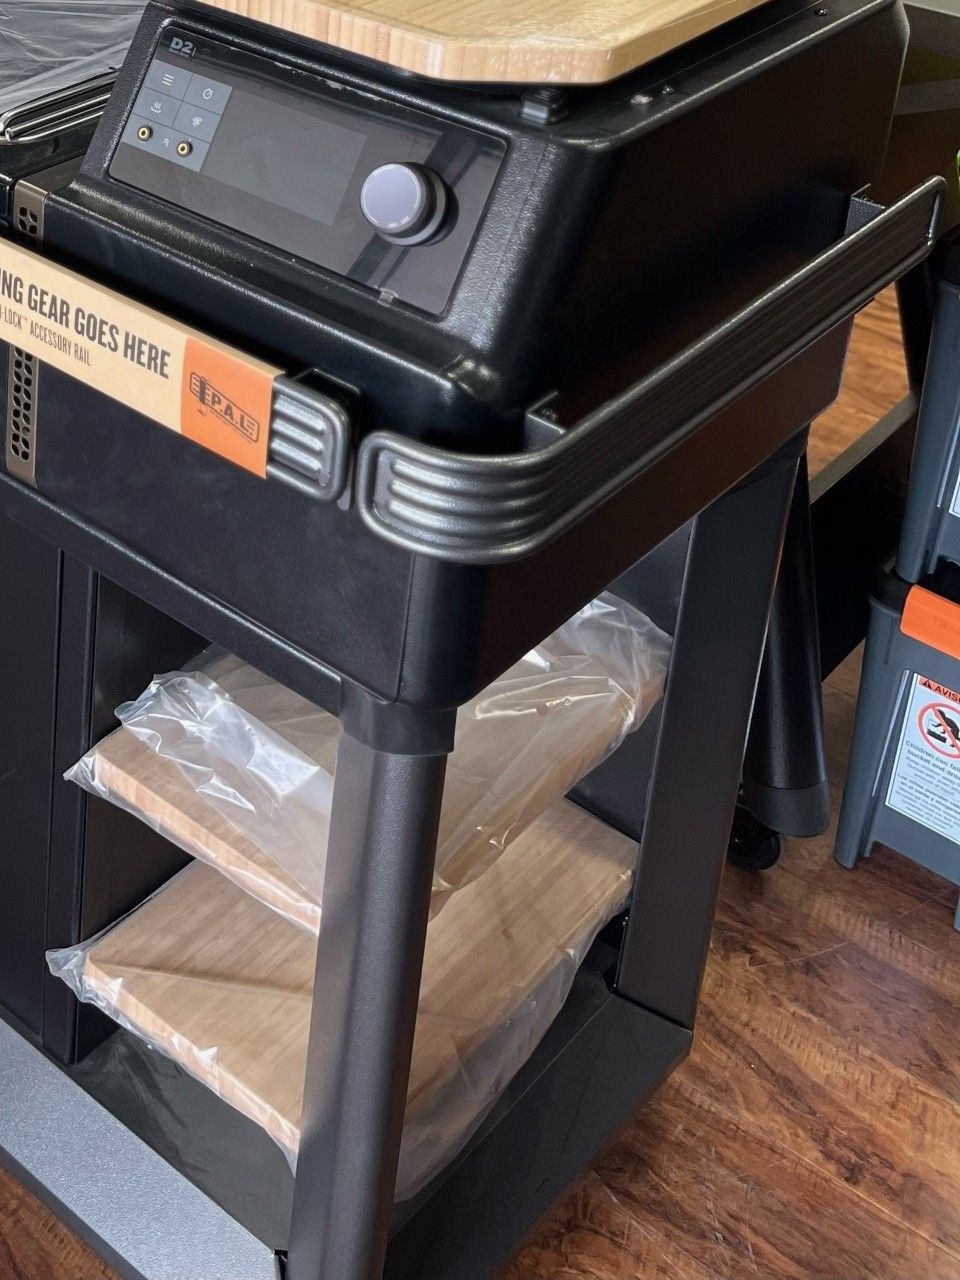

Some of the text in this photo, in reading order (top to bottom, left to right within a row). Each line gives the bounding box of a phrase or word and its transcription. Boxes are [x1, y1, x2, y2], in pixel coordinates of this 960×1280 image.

[170, 36, 193, 54] D2
[27, 283, 71, 329] GEAR
[74, 307, 120, 354] GOES
[123, 332, 171, 380] HERE
[29, 322, 72, 357] ACCESSORY
[74, 343, 92, 368] RAIL
[934, 686, 960, 703] AVIS
[905, 740, 935, 759] Children
[935, 756, 949, 766] can
[906, 749, 931, 765] bucket
[932, 762, 946, 772] and
